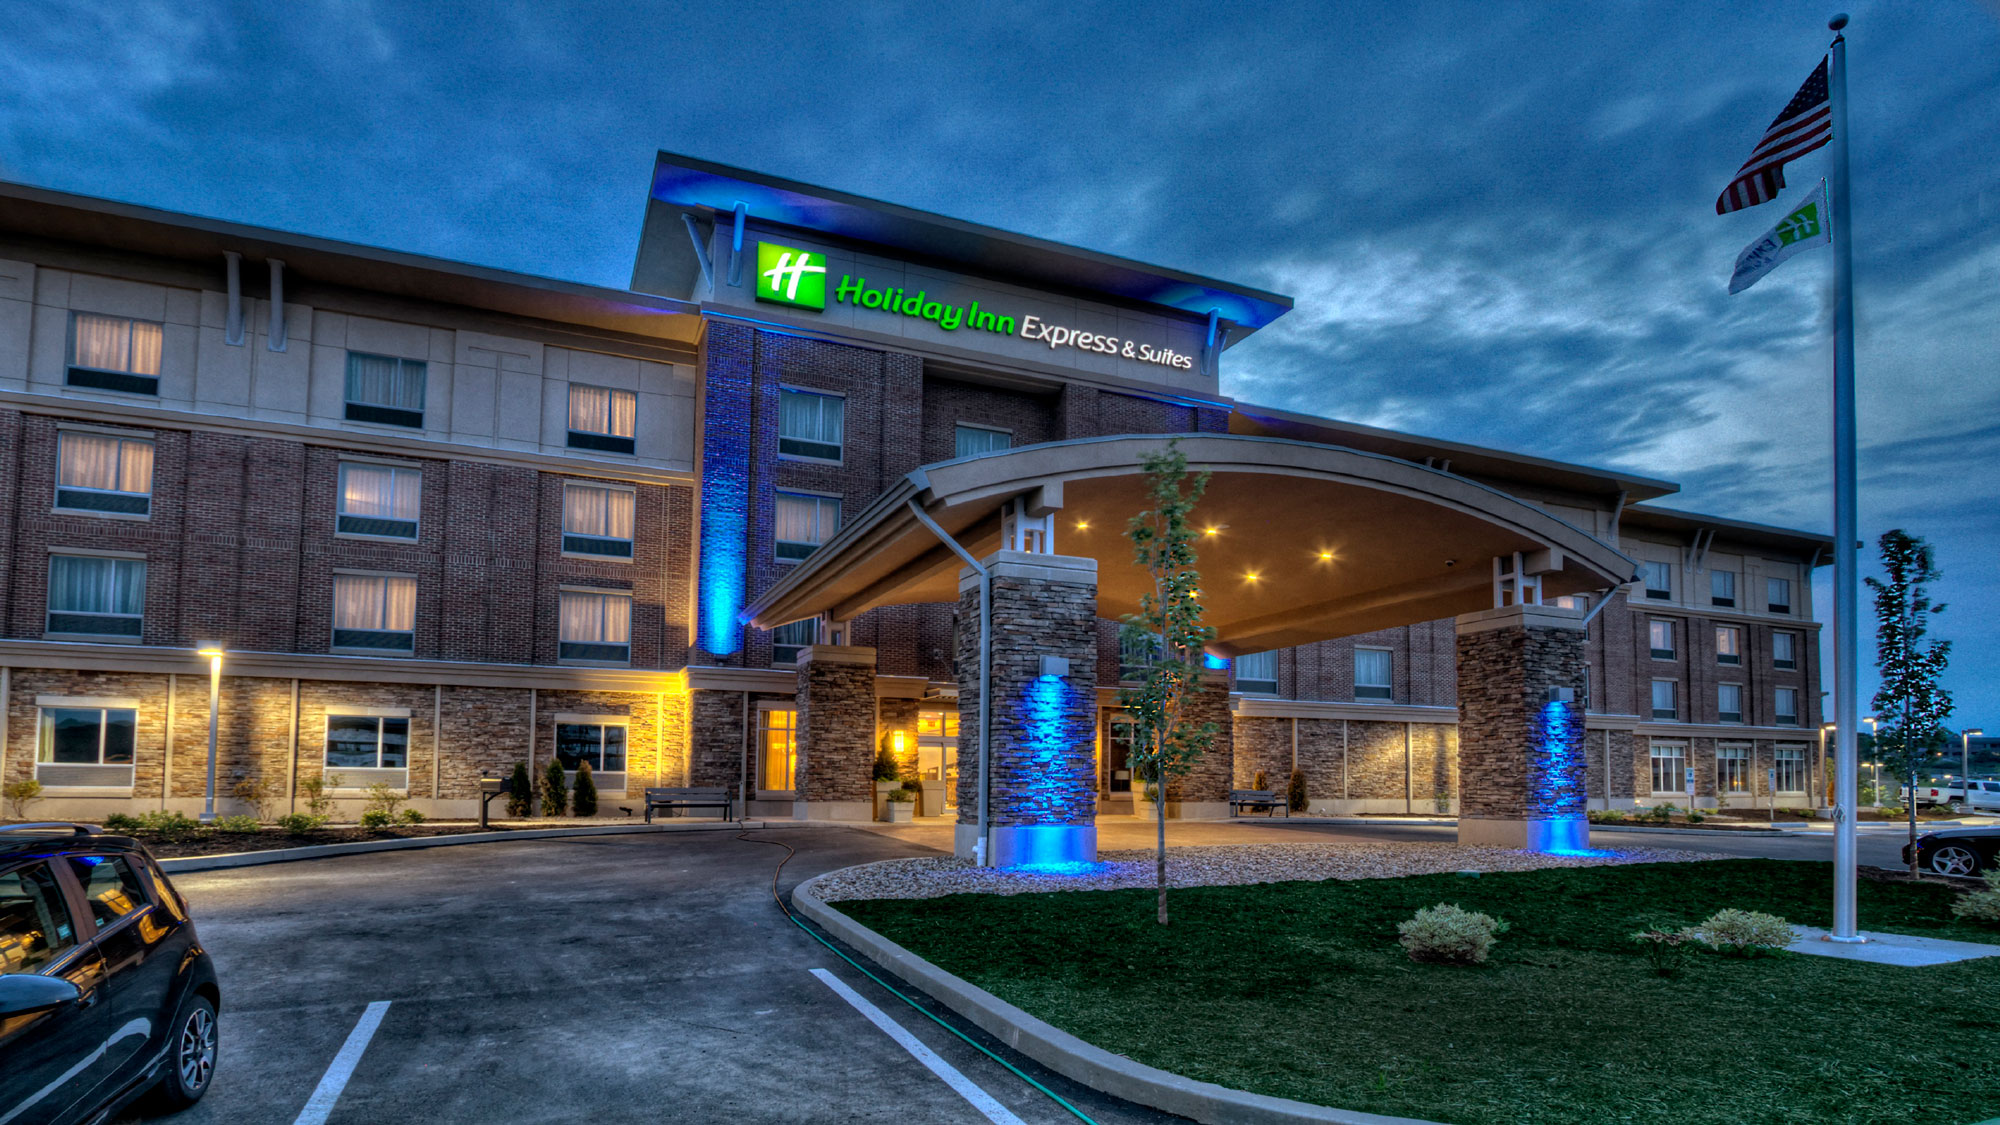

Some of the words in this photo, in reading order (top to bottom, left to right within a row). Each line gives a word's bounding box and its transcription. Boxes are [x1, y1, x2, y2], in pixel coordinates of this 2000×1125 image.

[835, 274, 964, 331] Holiday
[966, 301, 1015, 335] Inn
[1020, 315, 1119, 354] Express
[1121, 340, 1135, 358] &
[1137, 344, 1192, 369] Suites
